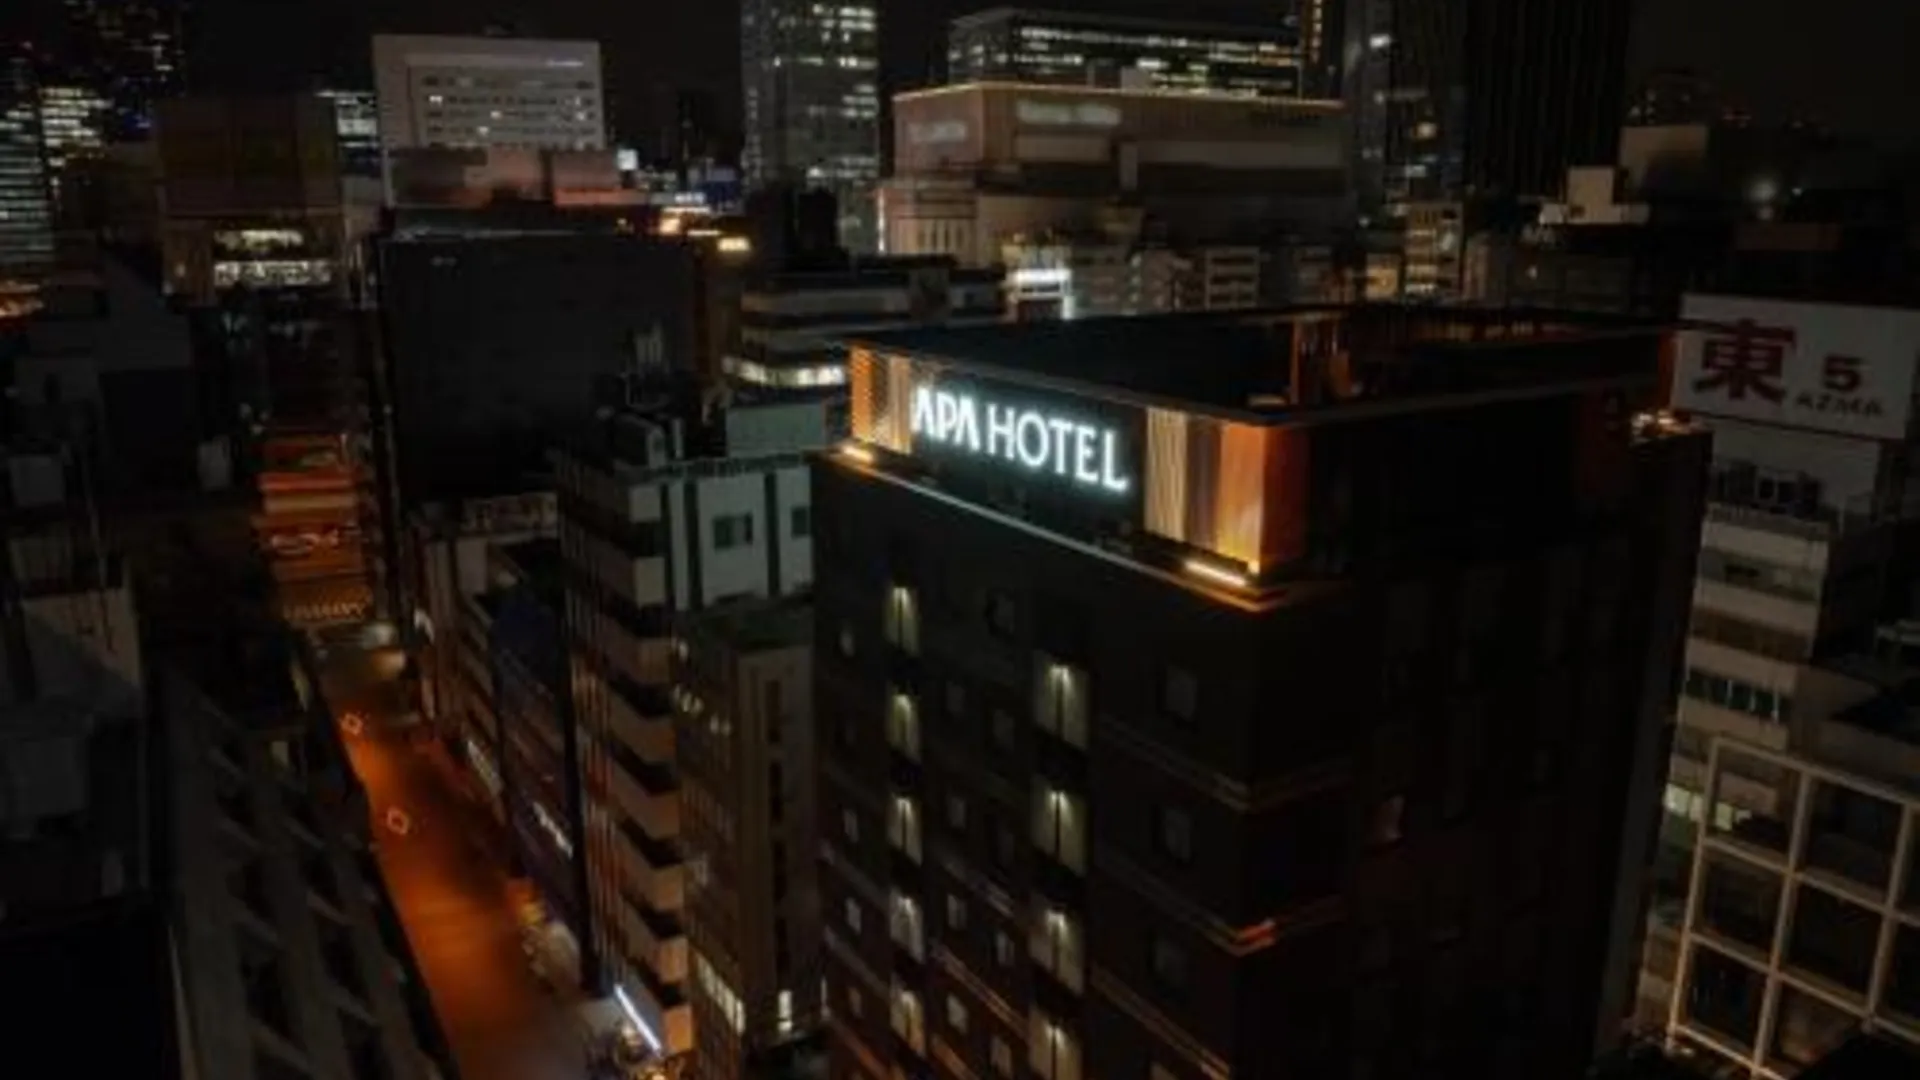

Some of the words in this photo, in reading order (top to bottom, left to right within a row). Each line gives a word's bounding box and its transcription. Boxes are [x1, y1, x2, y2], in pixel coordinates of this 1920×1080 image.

[1693, 318, 1795, 401] 東
[1822, 356, 1862, 392] 5
[911, 386, 981, 451] APA
[986, 403, 1130, 491] HOTEL
